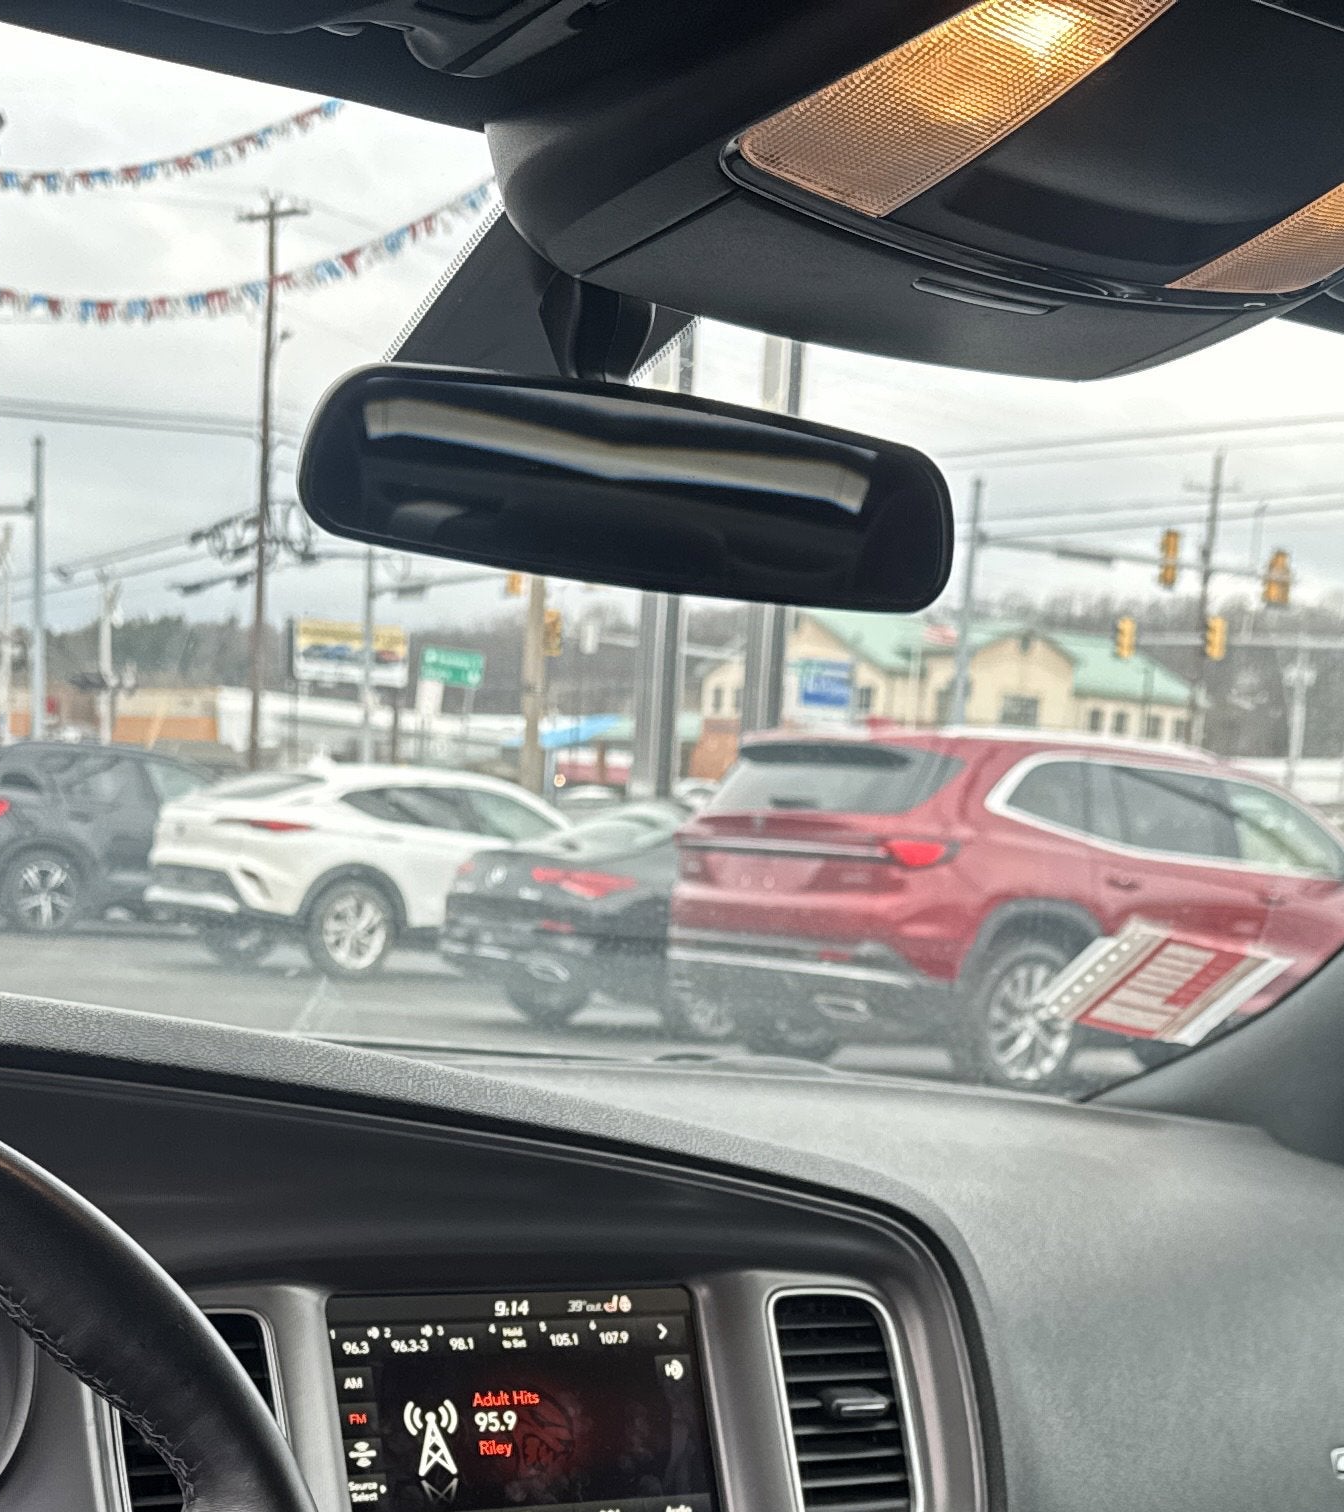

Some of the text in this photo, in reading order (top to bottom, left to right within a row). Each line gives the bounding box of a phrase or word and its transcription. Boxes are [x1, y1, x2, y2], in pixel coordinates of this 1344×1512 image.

[494, 1300, 529, 1317] 9:14
[449, 1336, 475, 1351] 98.1
[549, 1333, 579, 1347] 105.1
[599, 1330, 629, 1345] 107.9
[342, 1341, 370, 1355] 96.3
[344, 1377, 364, 1390] AM
[472, 1390, 540, 1407] Adult Hits
[348, 1413, 368, 1425] FM
[474, 1410, 518, 1432] 95.9
[478, 1440, 513, 1458] Riley
[348, 1481, 378, 1492] Source
[351, 1492, 378, 1503] Select
